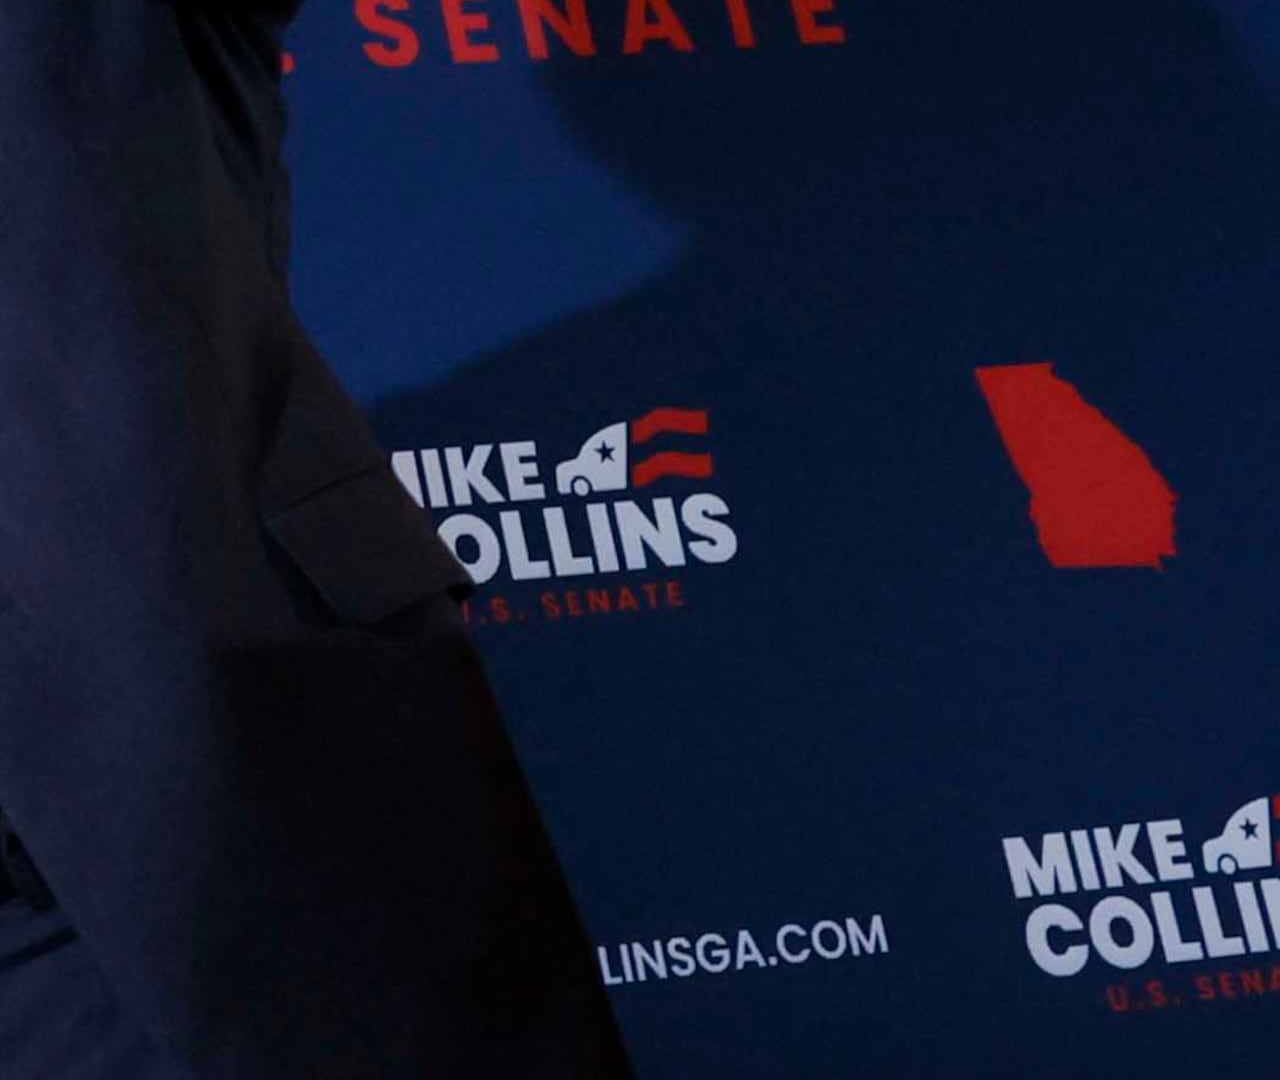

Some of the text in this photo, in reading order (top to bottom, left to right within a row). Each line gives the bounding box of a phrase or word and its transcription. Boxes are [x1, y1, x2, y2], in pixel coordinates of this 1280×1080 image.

[436, 493, 738, 586] OLLINS
[541, 581, 685, 618] SENATE
[1002, 819, 1195, 899] MIKE
[597, 914, 889, 985] LINSGA.COM
[1106, 980, 1185, 1012] U.S.
